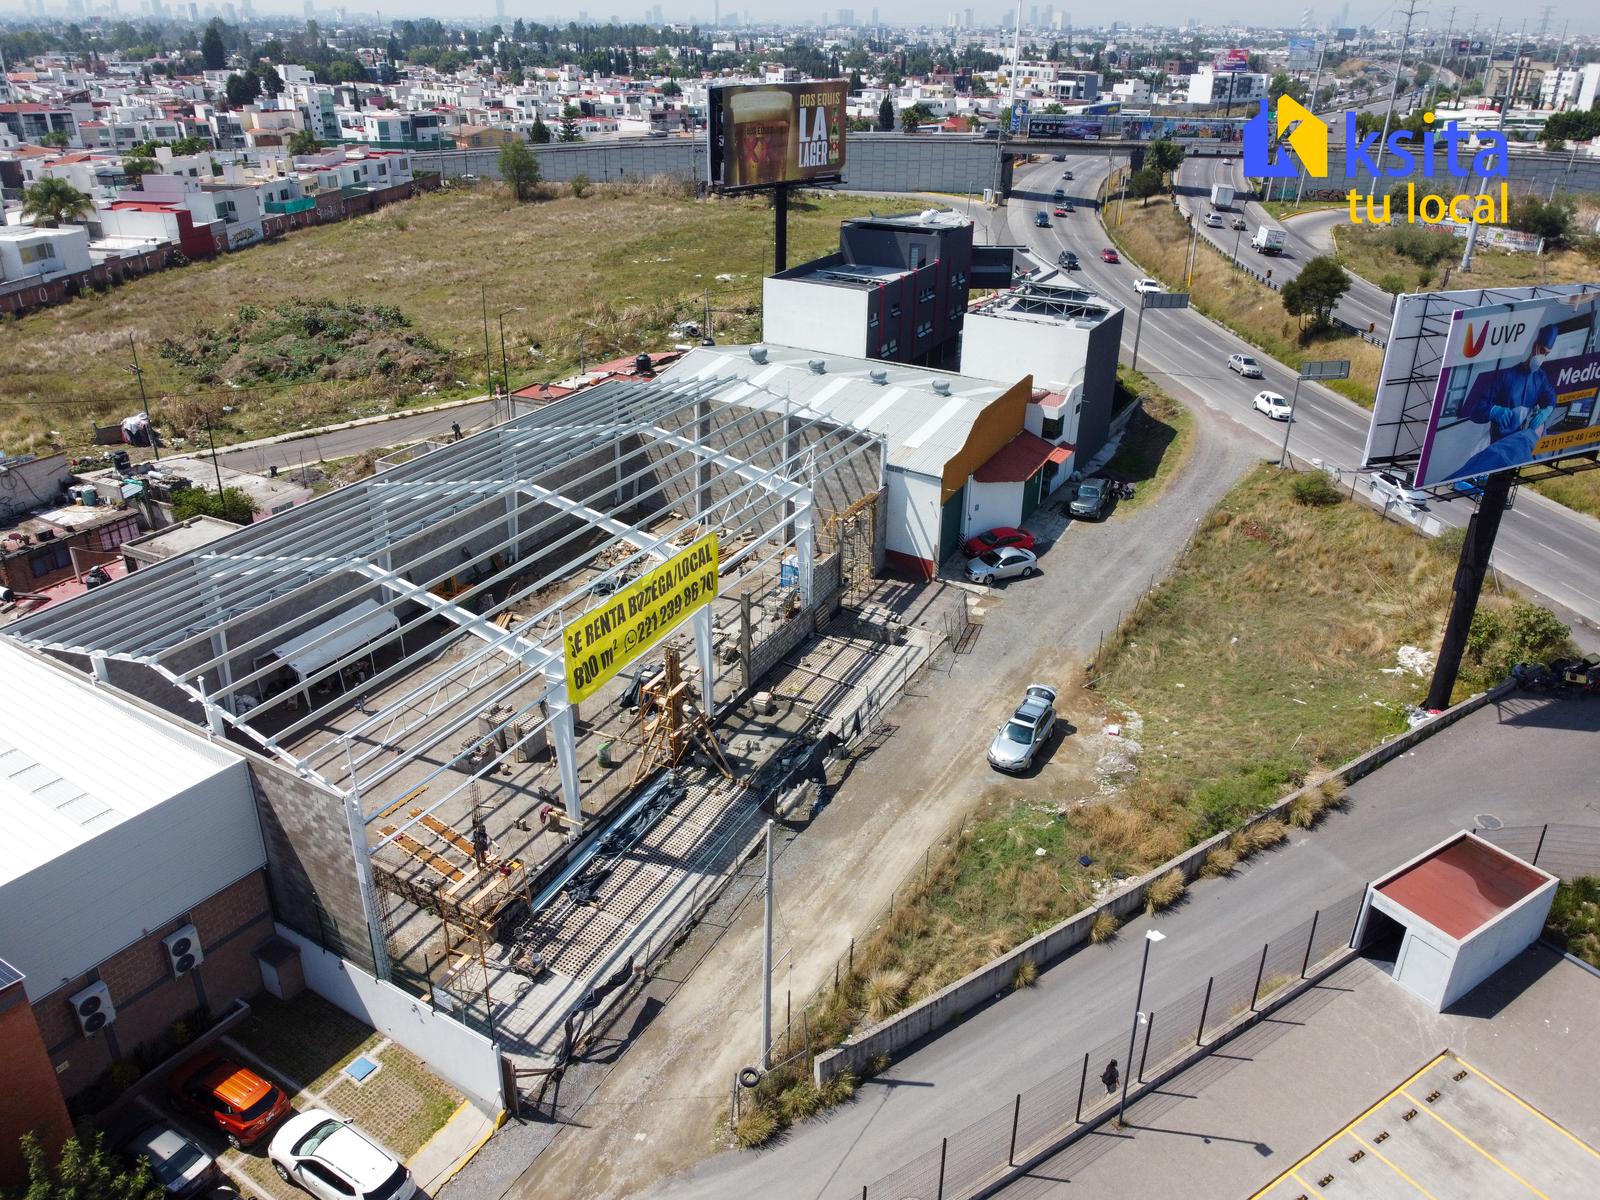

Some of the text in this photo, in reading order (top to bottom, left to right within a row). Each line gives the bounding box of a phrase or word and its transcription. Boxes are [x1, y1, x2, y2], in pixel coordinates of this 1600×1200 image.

[800, 92, 841, 107] DOS EQUIS
[799, 106, 828, 142] LA
[798, 141, 828, 168] LAGER
[1490, 322, 1526, 347] UVP
[573, 654, 599, 690] 800
[637, 611, 658, 644] 221
[659, 594, 682, 627] 239
[683, 581, 699, 608] 86
[700, 570, 714, 595] 70
[584, 602, 627, 647] RENTA
